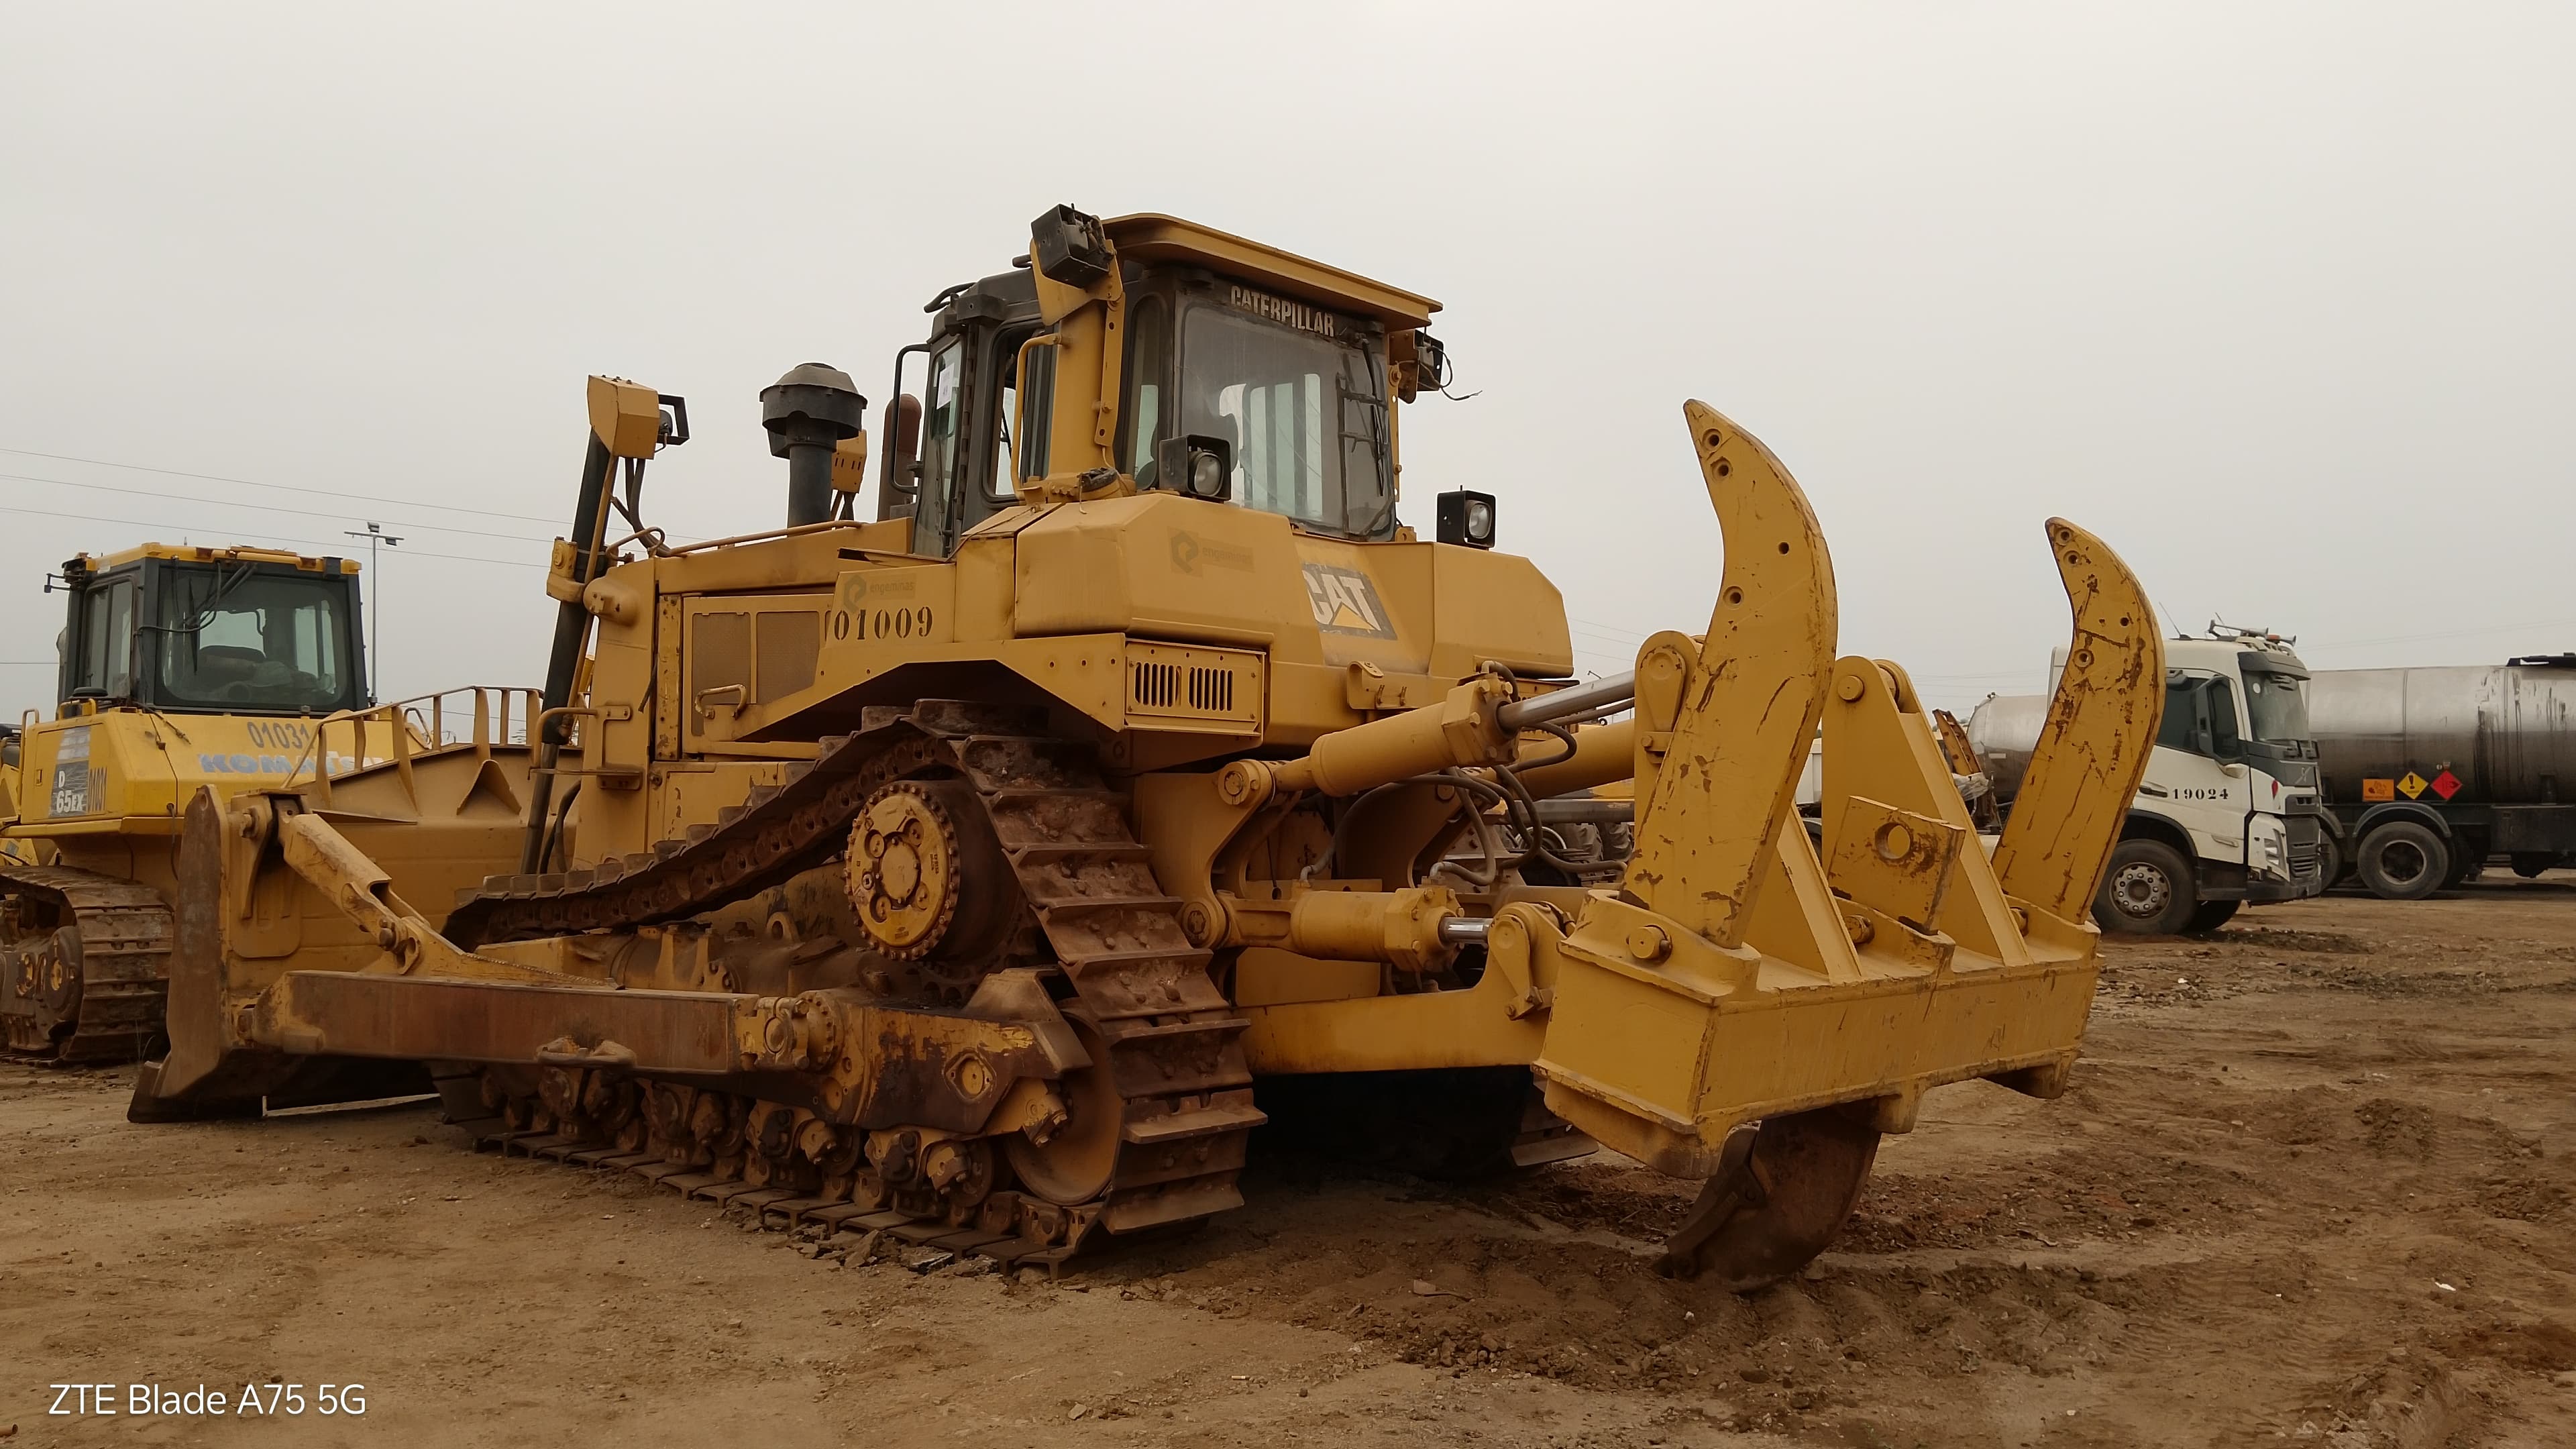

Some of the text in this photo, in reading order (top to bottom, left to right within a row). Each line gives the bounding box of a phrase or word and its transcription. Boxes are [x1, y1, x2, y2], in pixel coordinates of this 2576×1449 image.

[1230, 285, 1334, 337] CATERPILLAR
[1301, 570, 1382, 631] CAT
[834, 606, 933, 641] 01009
[58, 770, 66, 788] D
[56, 790, 85, 813] 65EX
[2173, 788, 2229, 800] 19024
